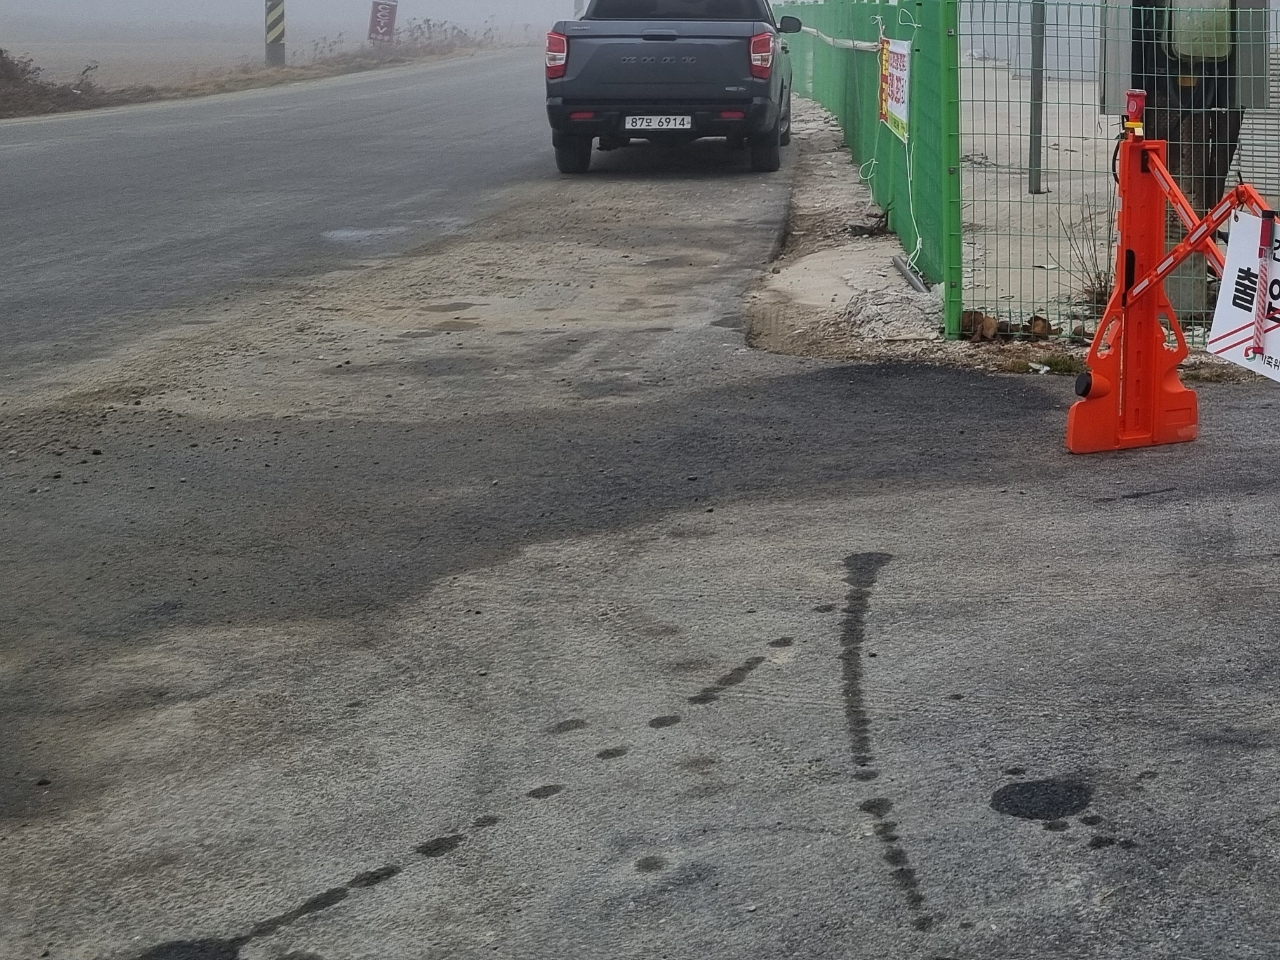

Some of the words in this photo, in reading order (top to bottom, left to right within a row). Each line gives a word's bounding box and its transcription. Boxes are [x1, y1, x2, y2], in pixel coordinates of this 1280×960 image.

[377, 5, 391, 32] CCTV
[630, 117, 653, 128] 87모
[656, 117, 686, 128] 6914
